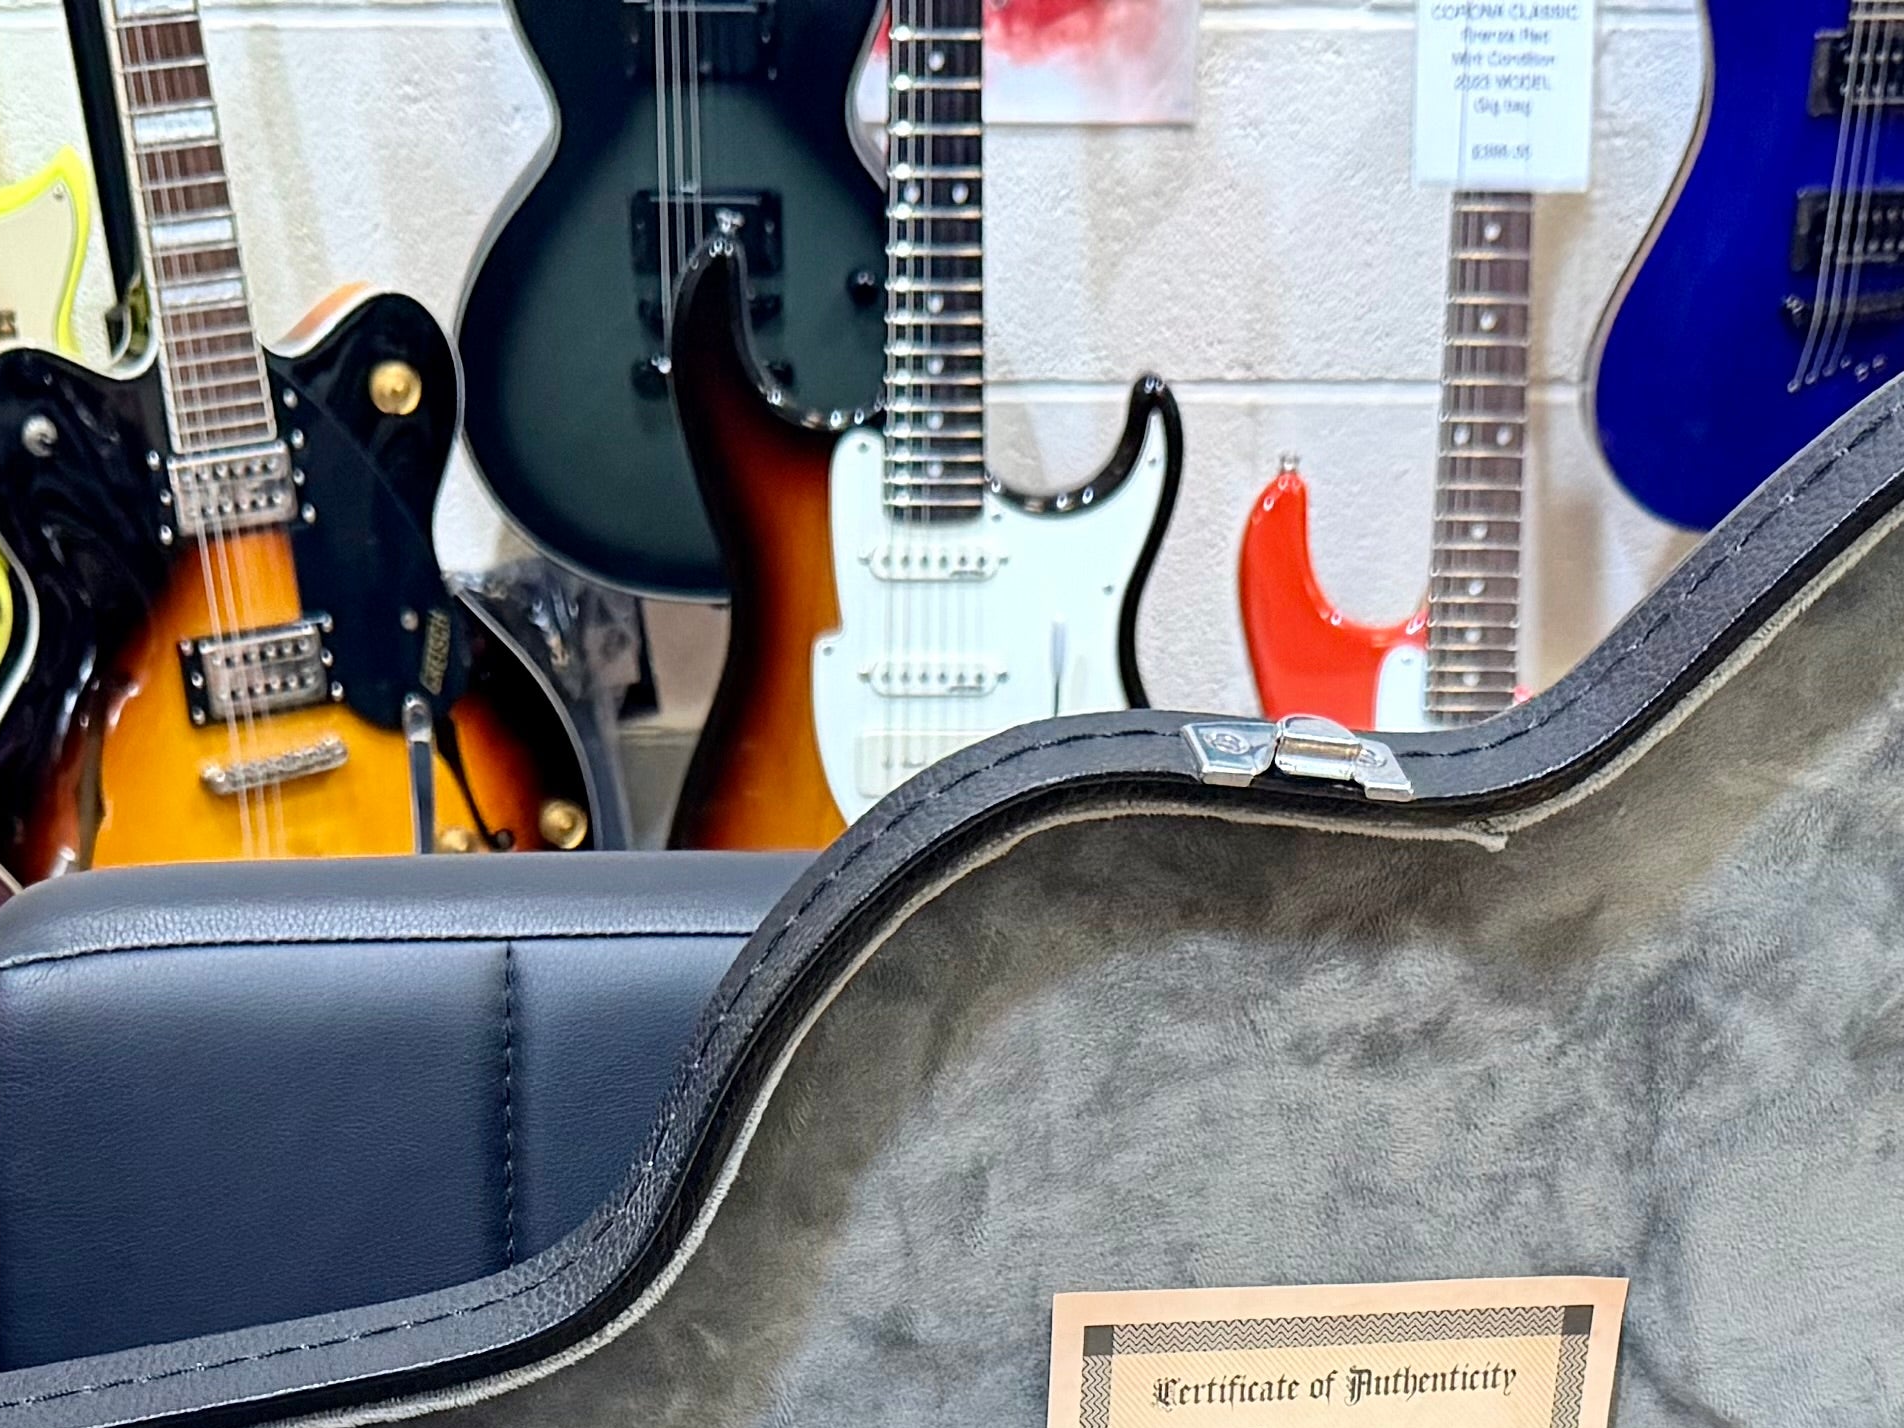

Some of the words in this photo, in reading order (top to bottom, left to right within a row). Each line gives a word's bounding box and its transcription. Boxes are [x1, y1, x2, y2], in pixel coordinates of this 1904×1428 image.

[1153, 1373, 1300, 1412] Certificate
[1310, 1369, 1338, 1406] of
[1344, 1361, 1517, 1407] Authenticity
